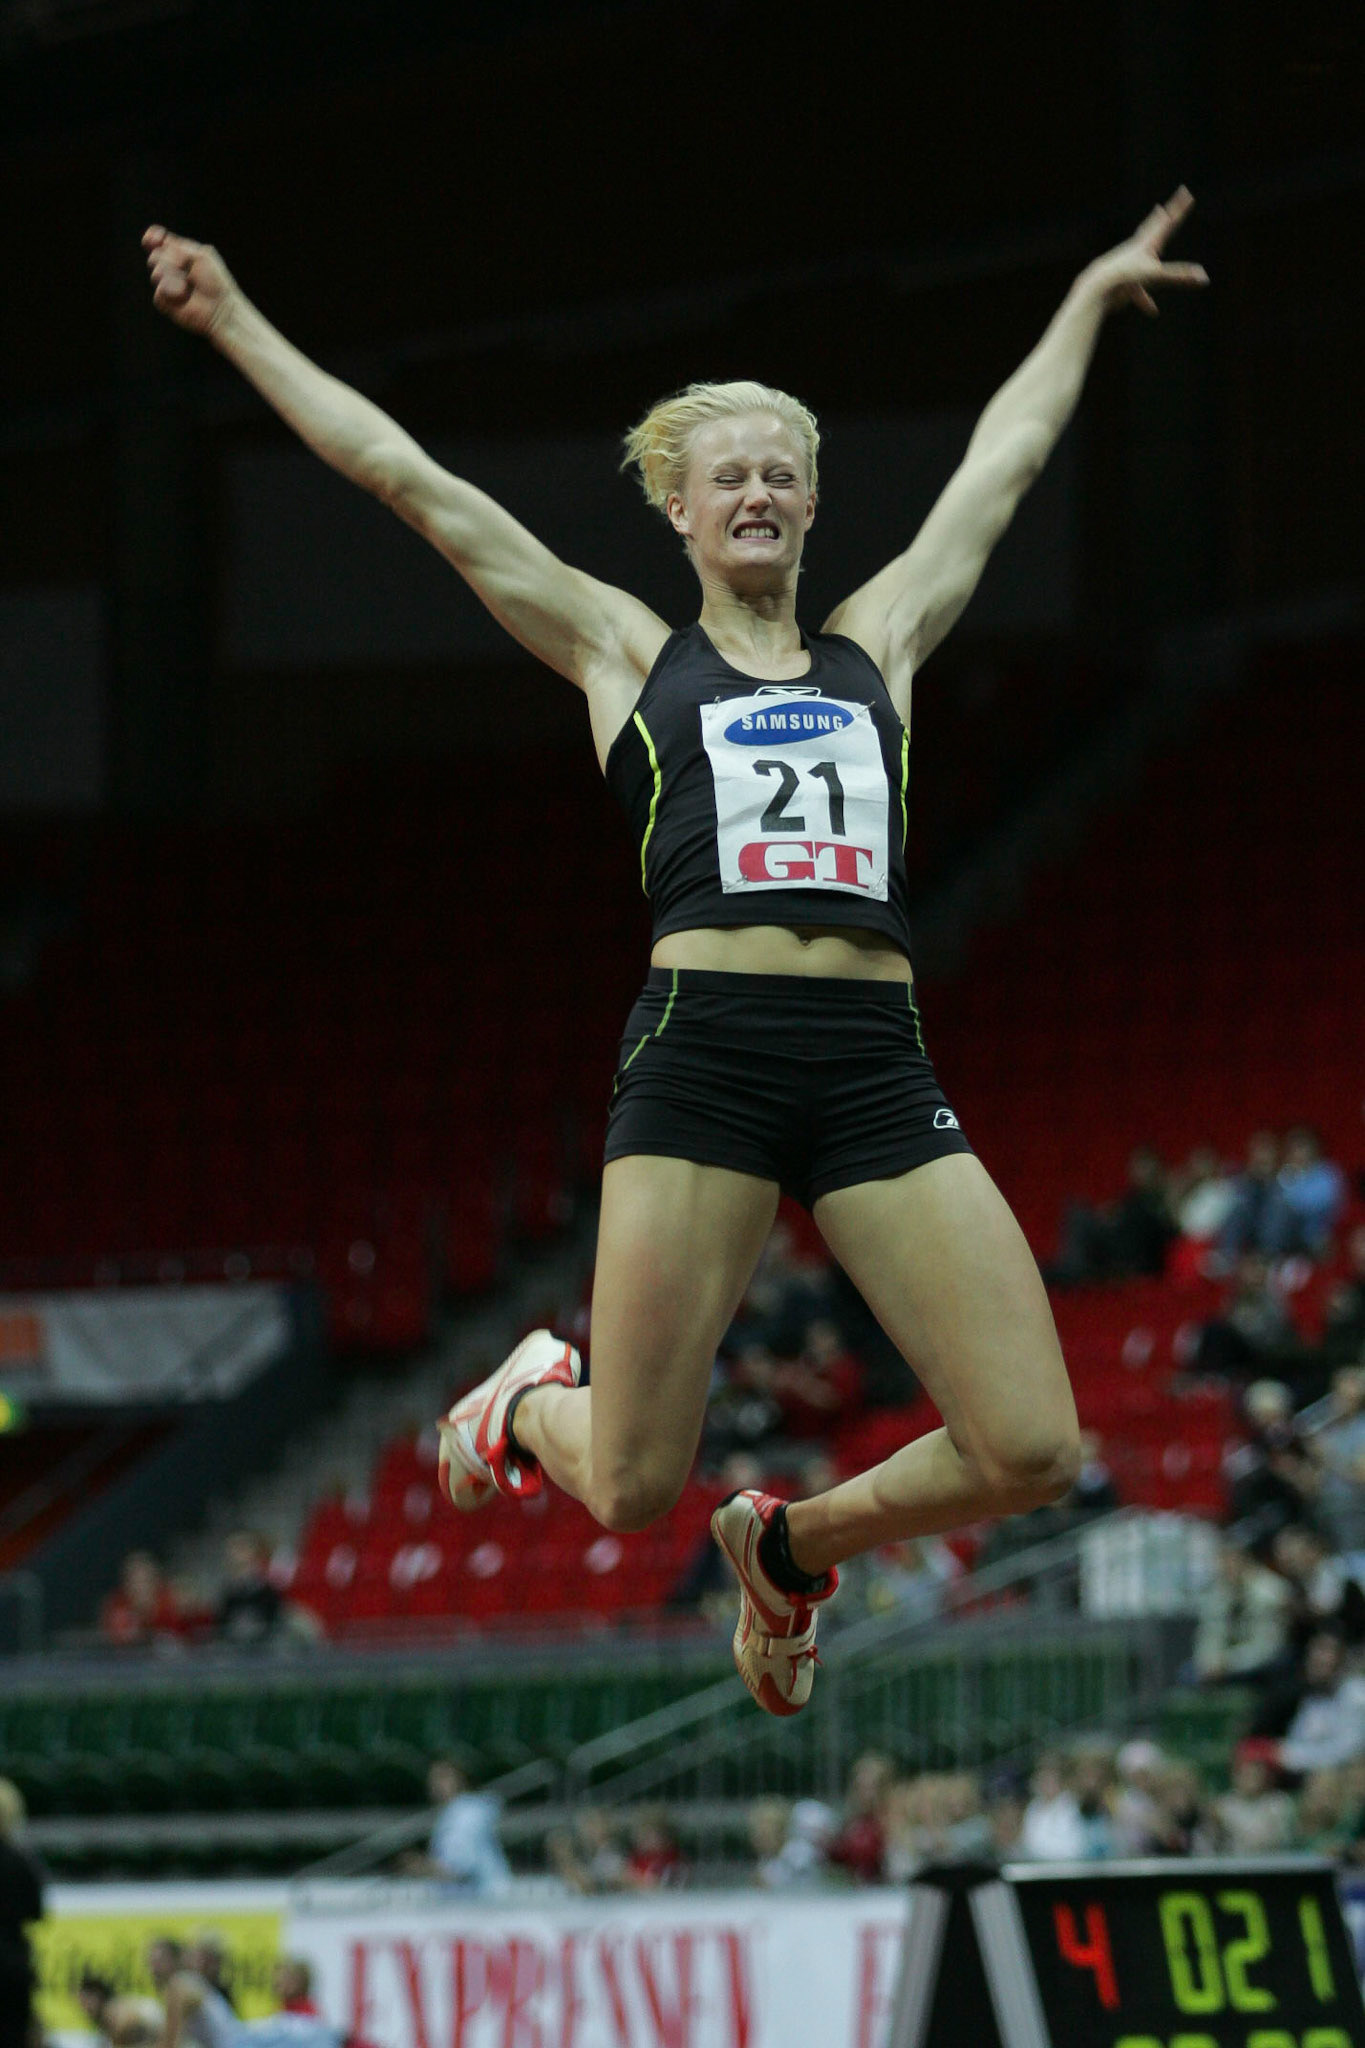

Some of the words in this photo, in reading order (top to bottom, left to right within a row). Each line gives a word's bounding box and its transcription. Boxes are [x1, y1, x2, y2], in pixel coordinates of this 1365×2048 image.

[741, 714, 844, 731] SAMSUNG
[752, 759, 846, 836] 21
[738, 840, 873, 889] GT
[1052, 1900, 1121, 2013] 4
